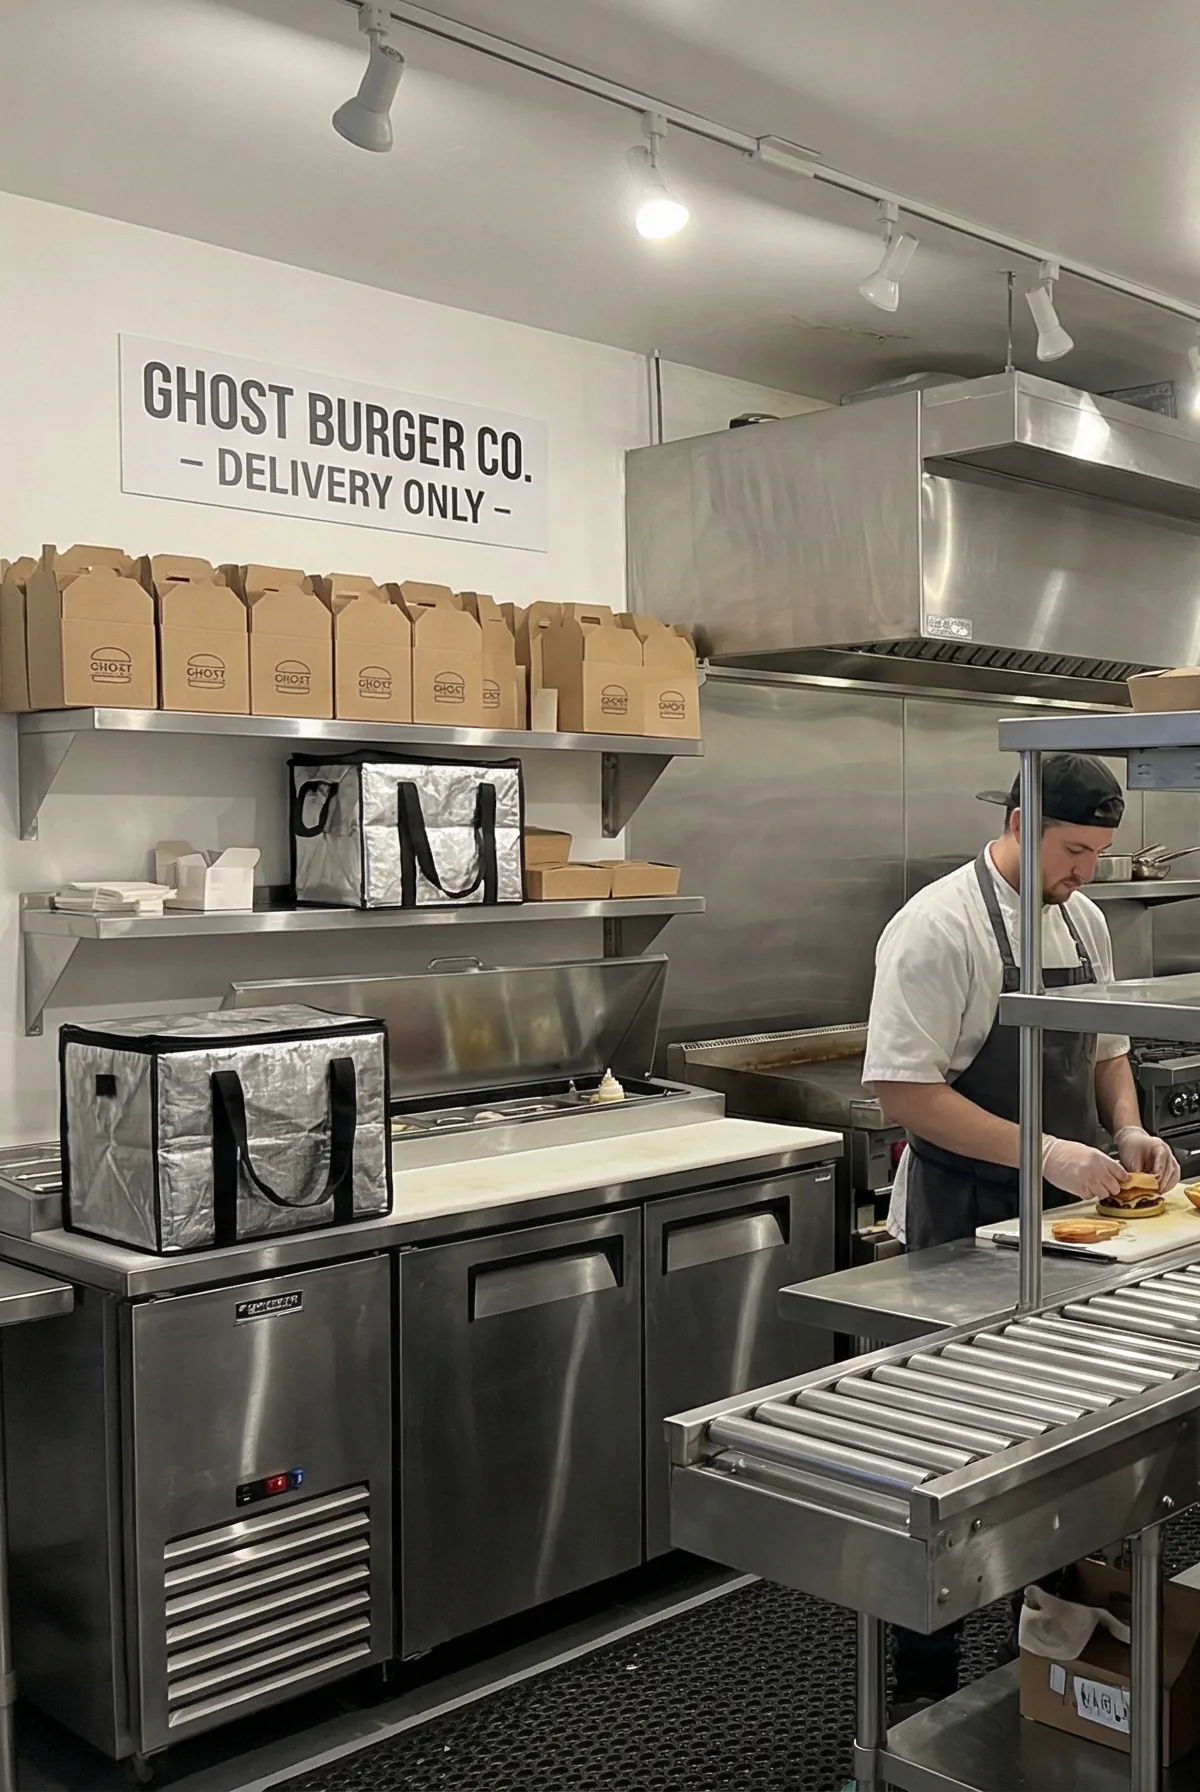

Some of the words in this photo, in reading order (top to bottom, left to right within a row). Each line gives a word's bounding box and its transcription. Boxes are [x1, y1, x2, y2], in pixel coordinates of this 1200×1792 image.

[144, 361, 294, 440] GHOST
[308, 392, 466, 471] BURGER
[477, 426, 532, 483] CO.
[218, 448, 393, 509] DELIVERY
[404, 479, 485, 524] ONLY
